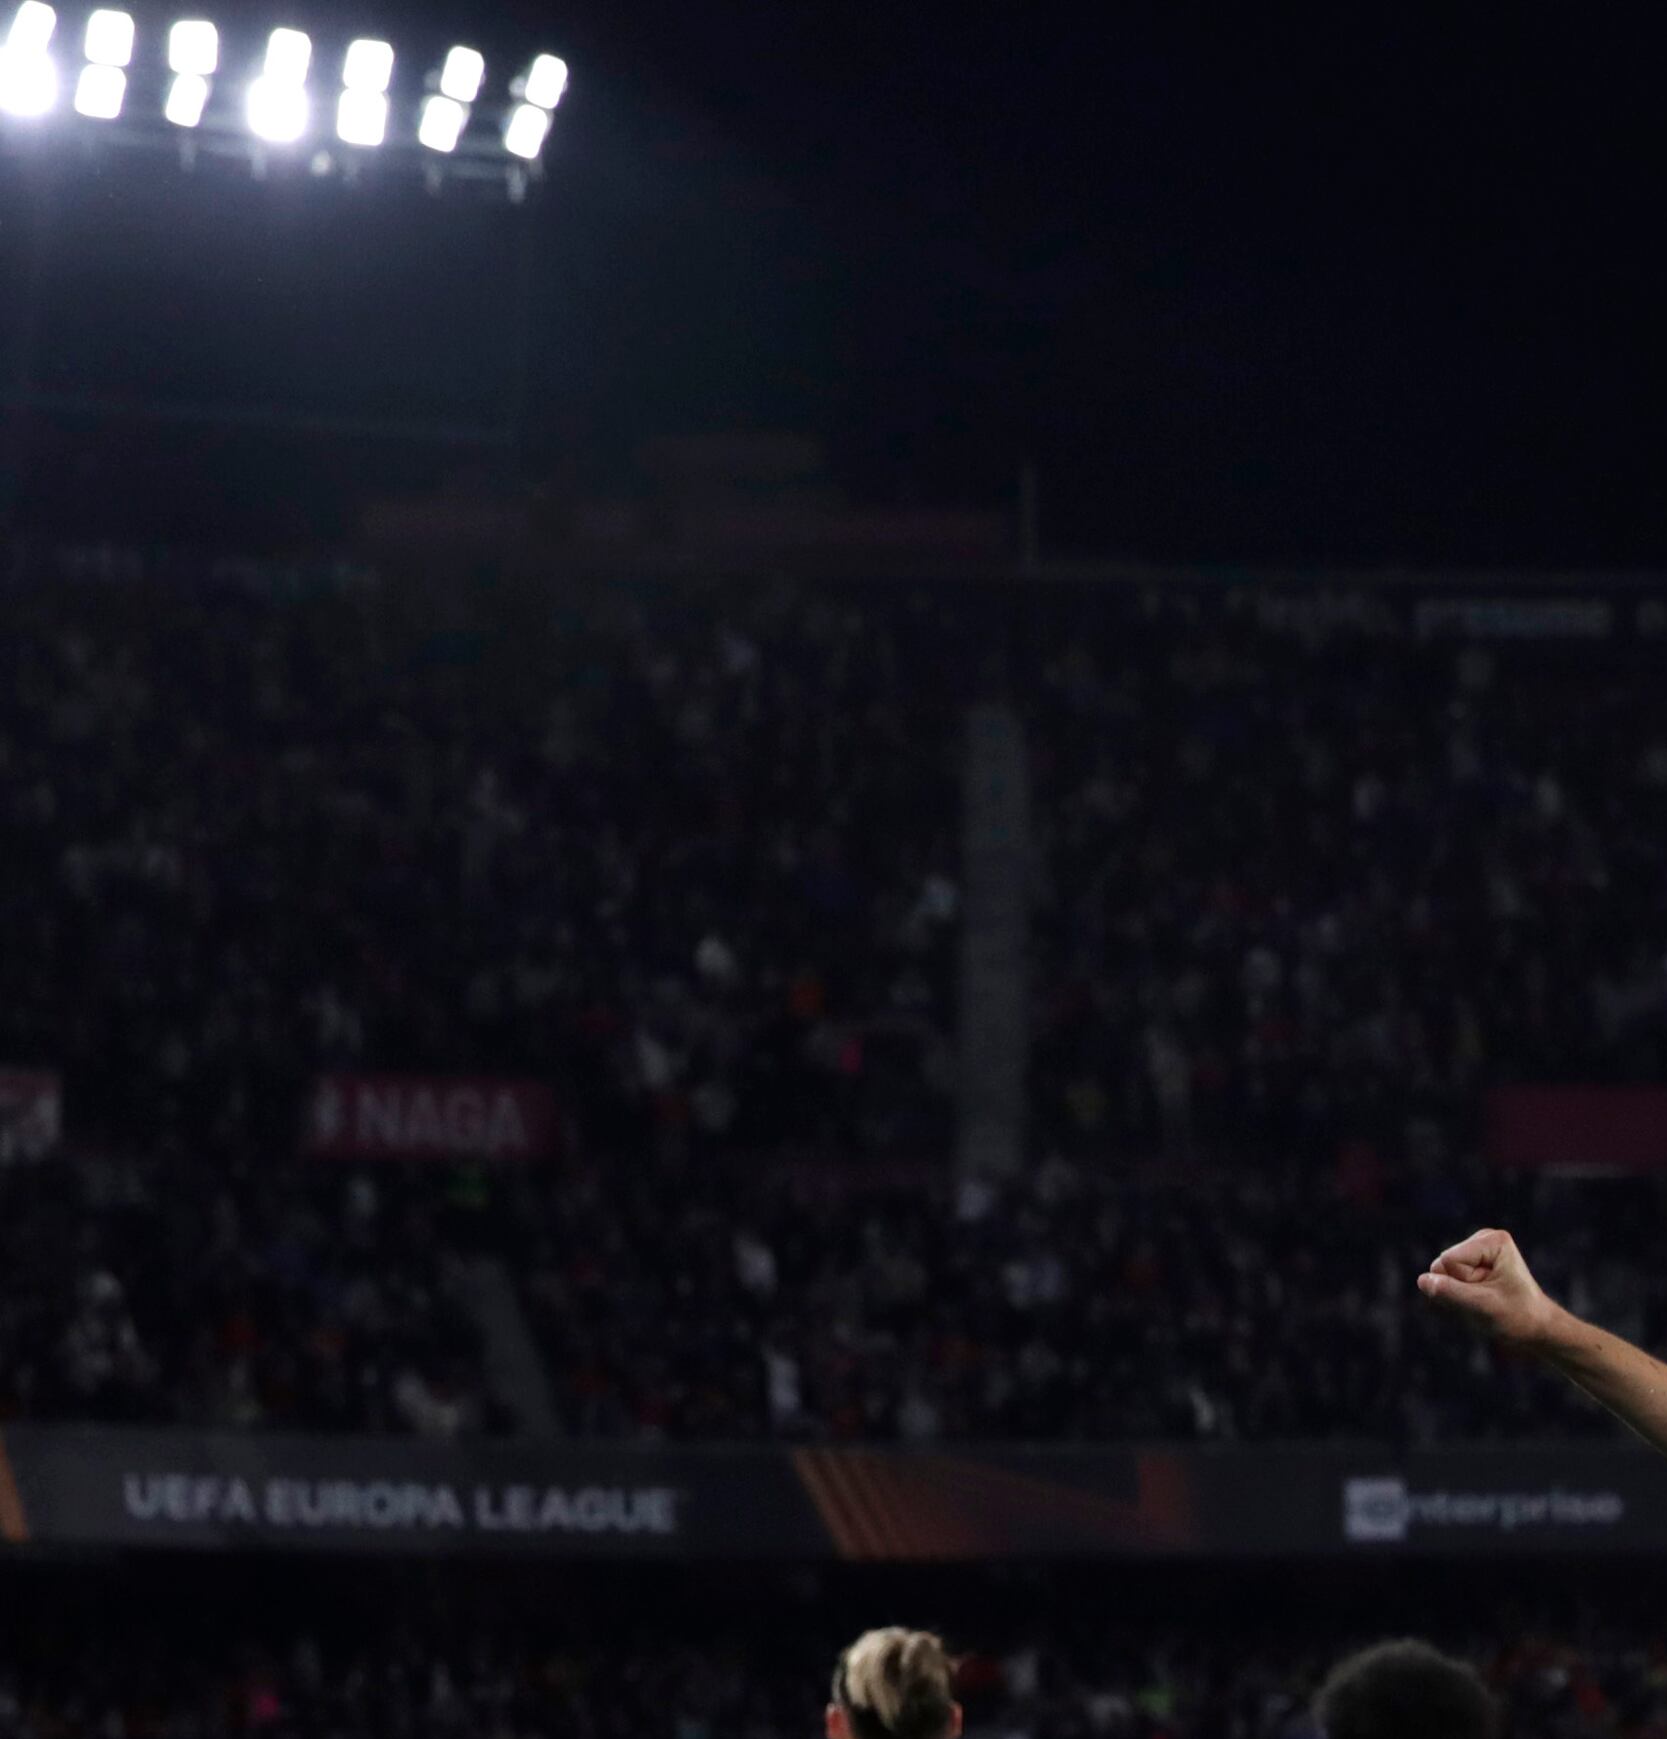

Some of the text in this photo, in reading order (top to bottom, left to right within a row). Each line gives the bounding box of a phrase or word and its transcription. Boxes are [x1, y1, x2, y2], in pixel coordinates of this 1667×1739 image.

[356, 1078, 529, 1153] NAGA
[122, 1474, 676, 1533] UEFA EUROPA LEAGUE
